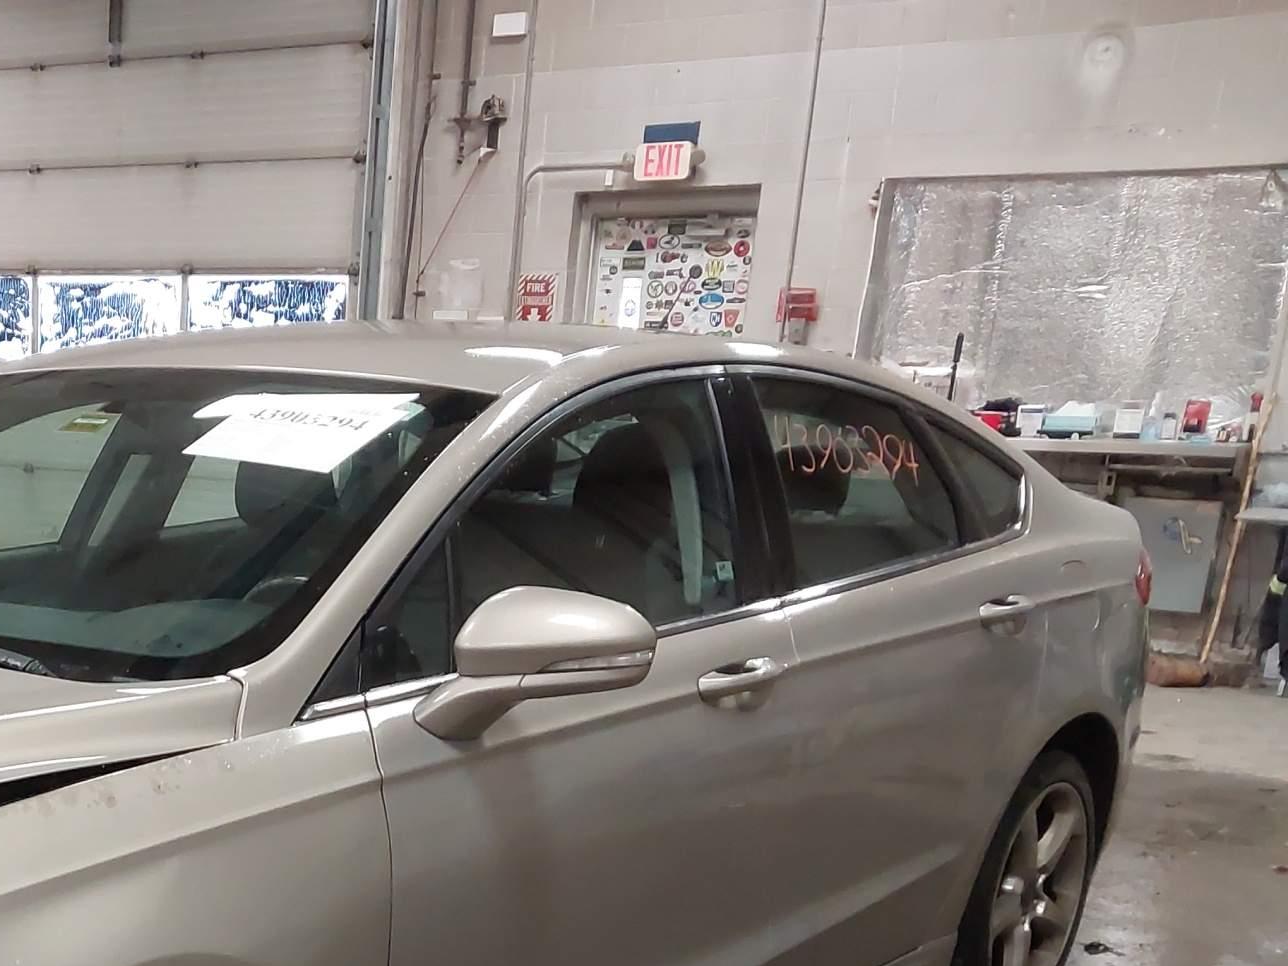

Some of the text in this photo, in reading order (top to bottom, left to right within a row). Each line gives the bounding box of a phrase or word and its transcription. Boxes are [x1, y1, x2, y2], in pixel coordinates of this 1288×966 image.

[643, 144, 684, 177] EXIT
[526, 282, 546, 293] FIRE
[774, 415, 919, 487] 43903294
